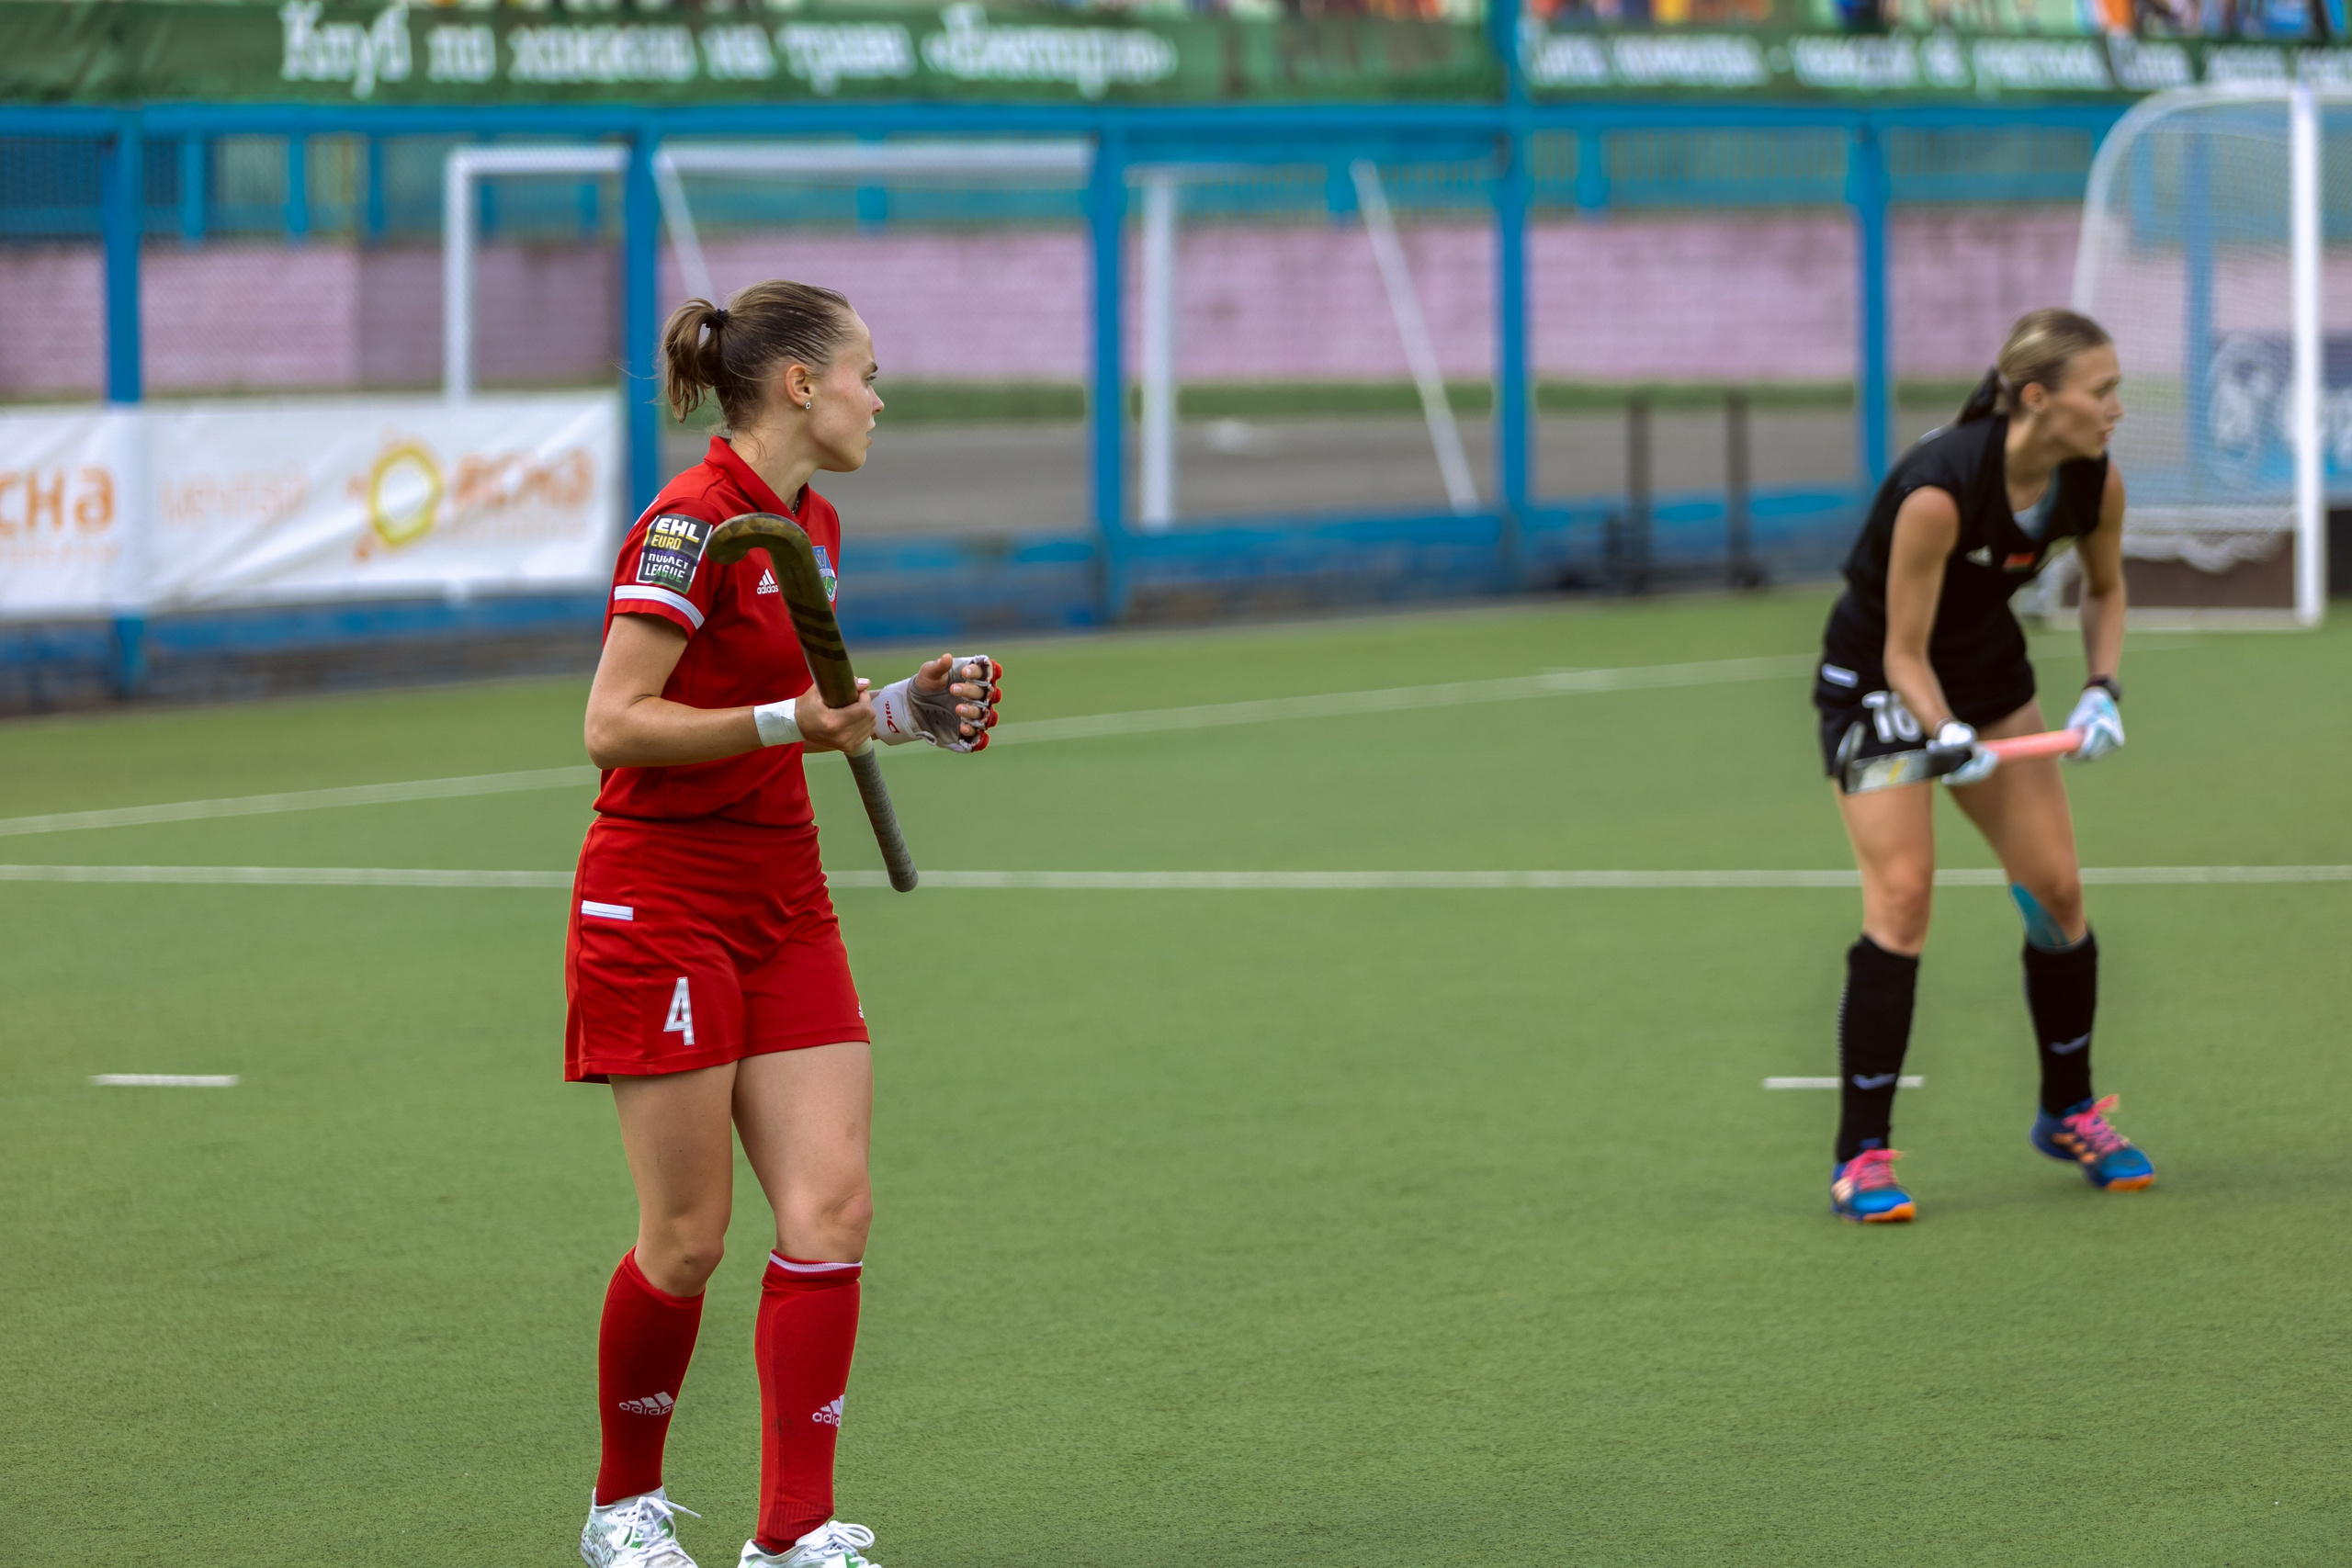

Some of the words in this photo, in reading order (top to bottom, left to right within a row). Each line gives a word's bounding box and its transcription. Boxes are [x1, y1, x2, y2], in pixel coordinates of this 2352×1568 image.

[655, 517, 700, 543] EHL
[650, 534, 683, 550] EURO
[648, 548, 692, 570] HOCKEY
[644, 562, 685, 583] LEAGUE
[756, 584, 779, 595] adidas
[662, 976, 695, 1045] 4
[811, 1410, 842, 1427] adid
